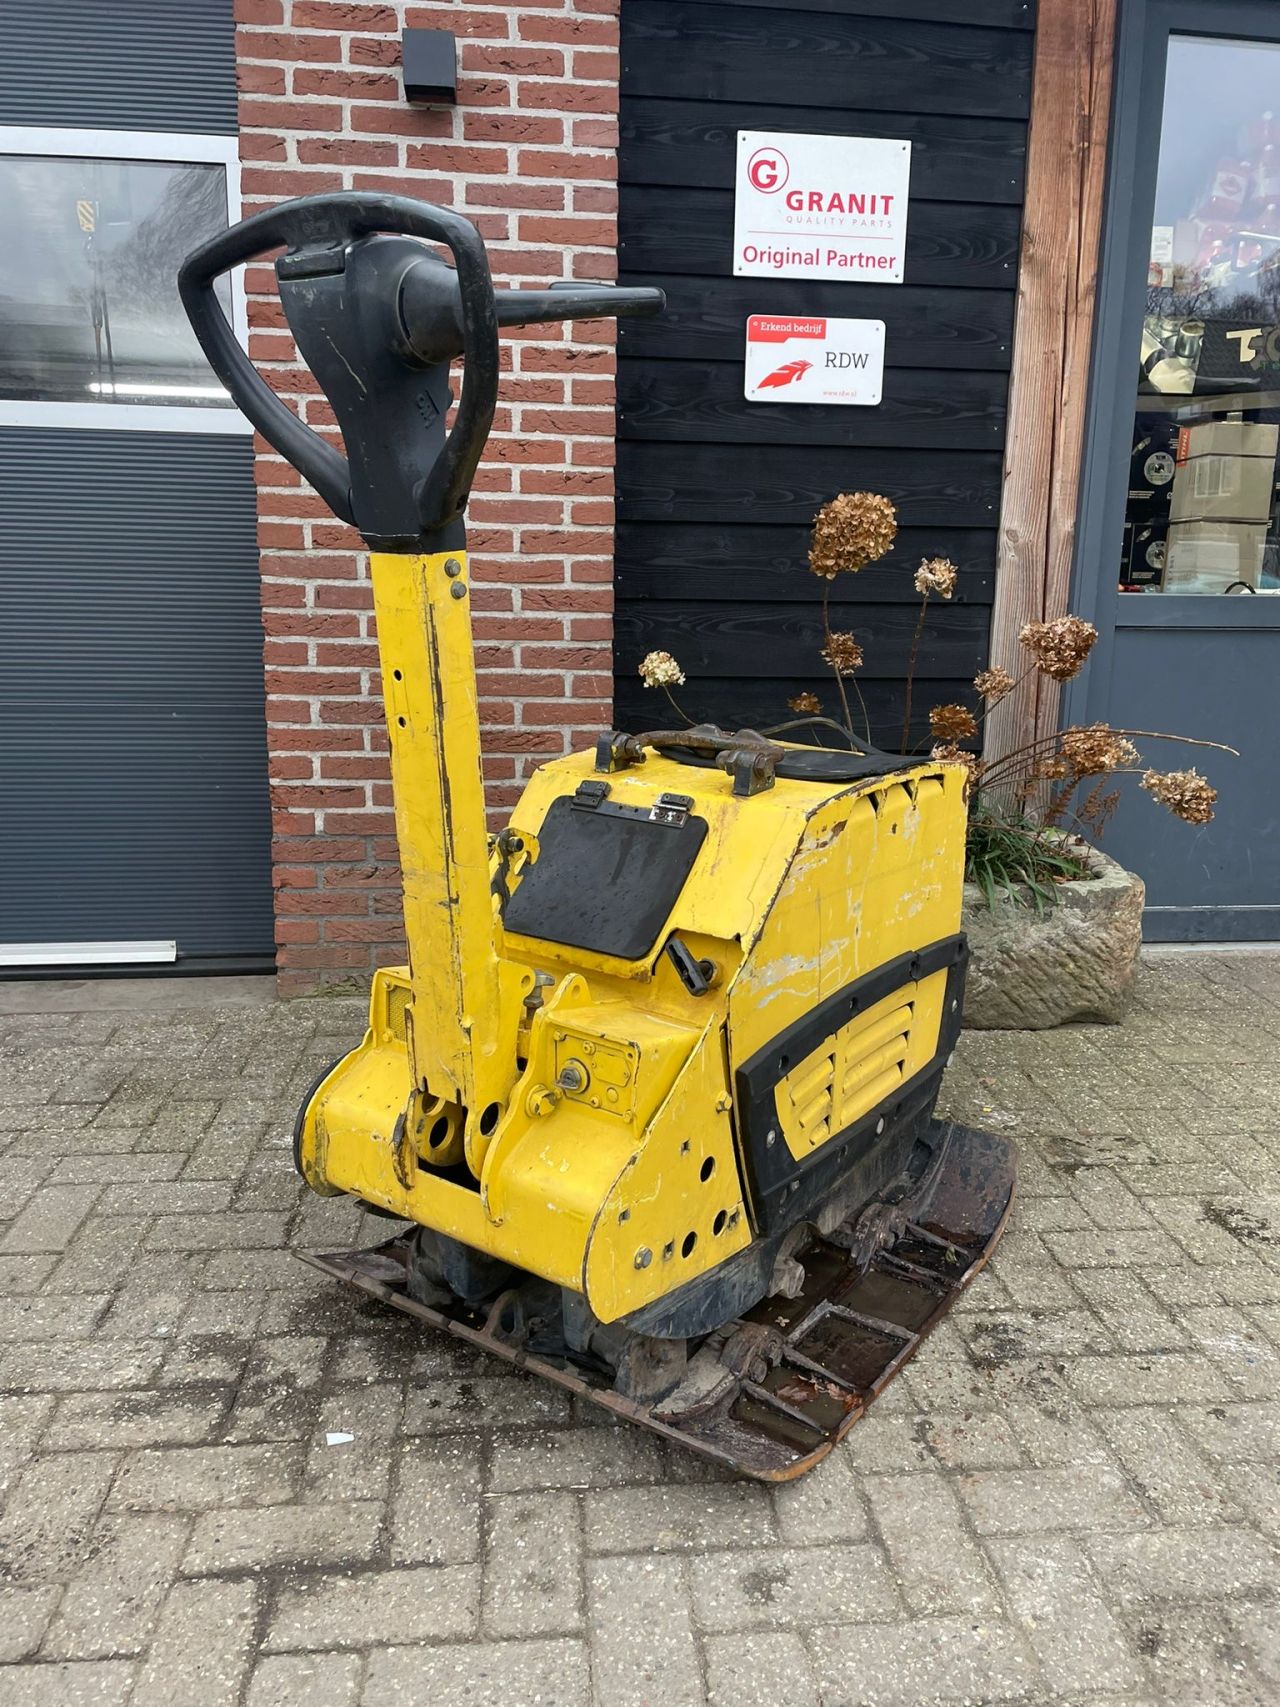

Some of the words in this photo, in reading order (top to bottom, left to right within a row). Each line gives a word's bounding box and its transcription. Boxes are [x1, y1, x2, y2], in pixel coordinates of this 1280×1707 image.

[751, 159, 778, 189] G
[786, 190, 894, 215] GRANIT
[786, 215, 845, 225] QUALITY
[852, 219, 892, 228] PARTS
[743, 245, 820, 269] Original
[827, 249, 896, 269] Partner
[761, 321, 792, 332] Erkend
[793, 323, 822, 336] bedrijf
[825, 351, 869, 369] RDW
